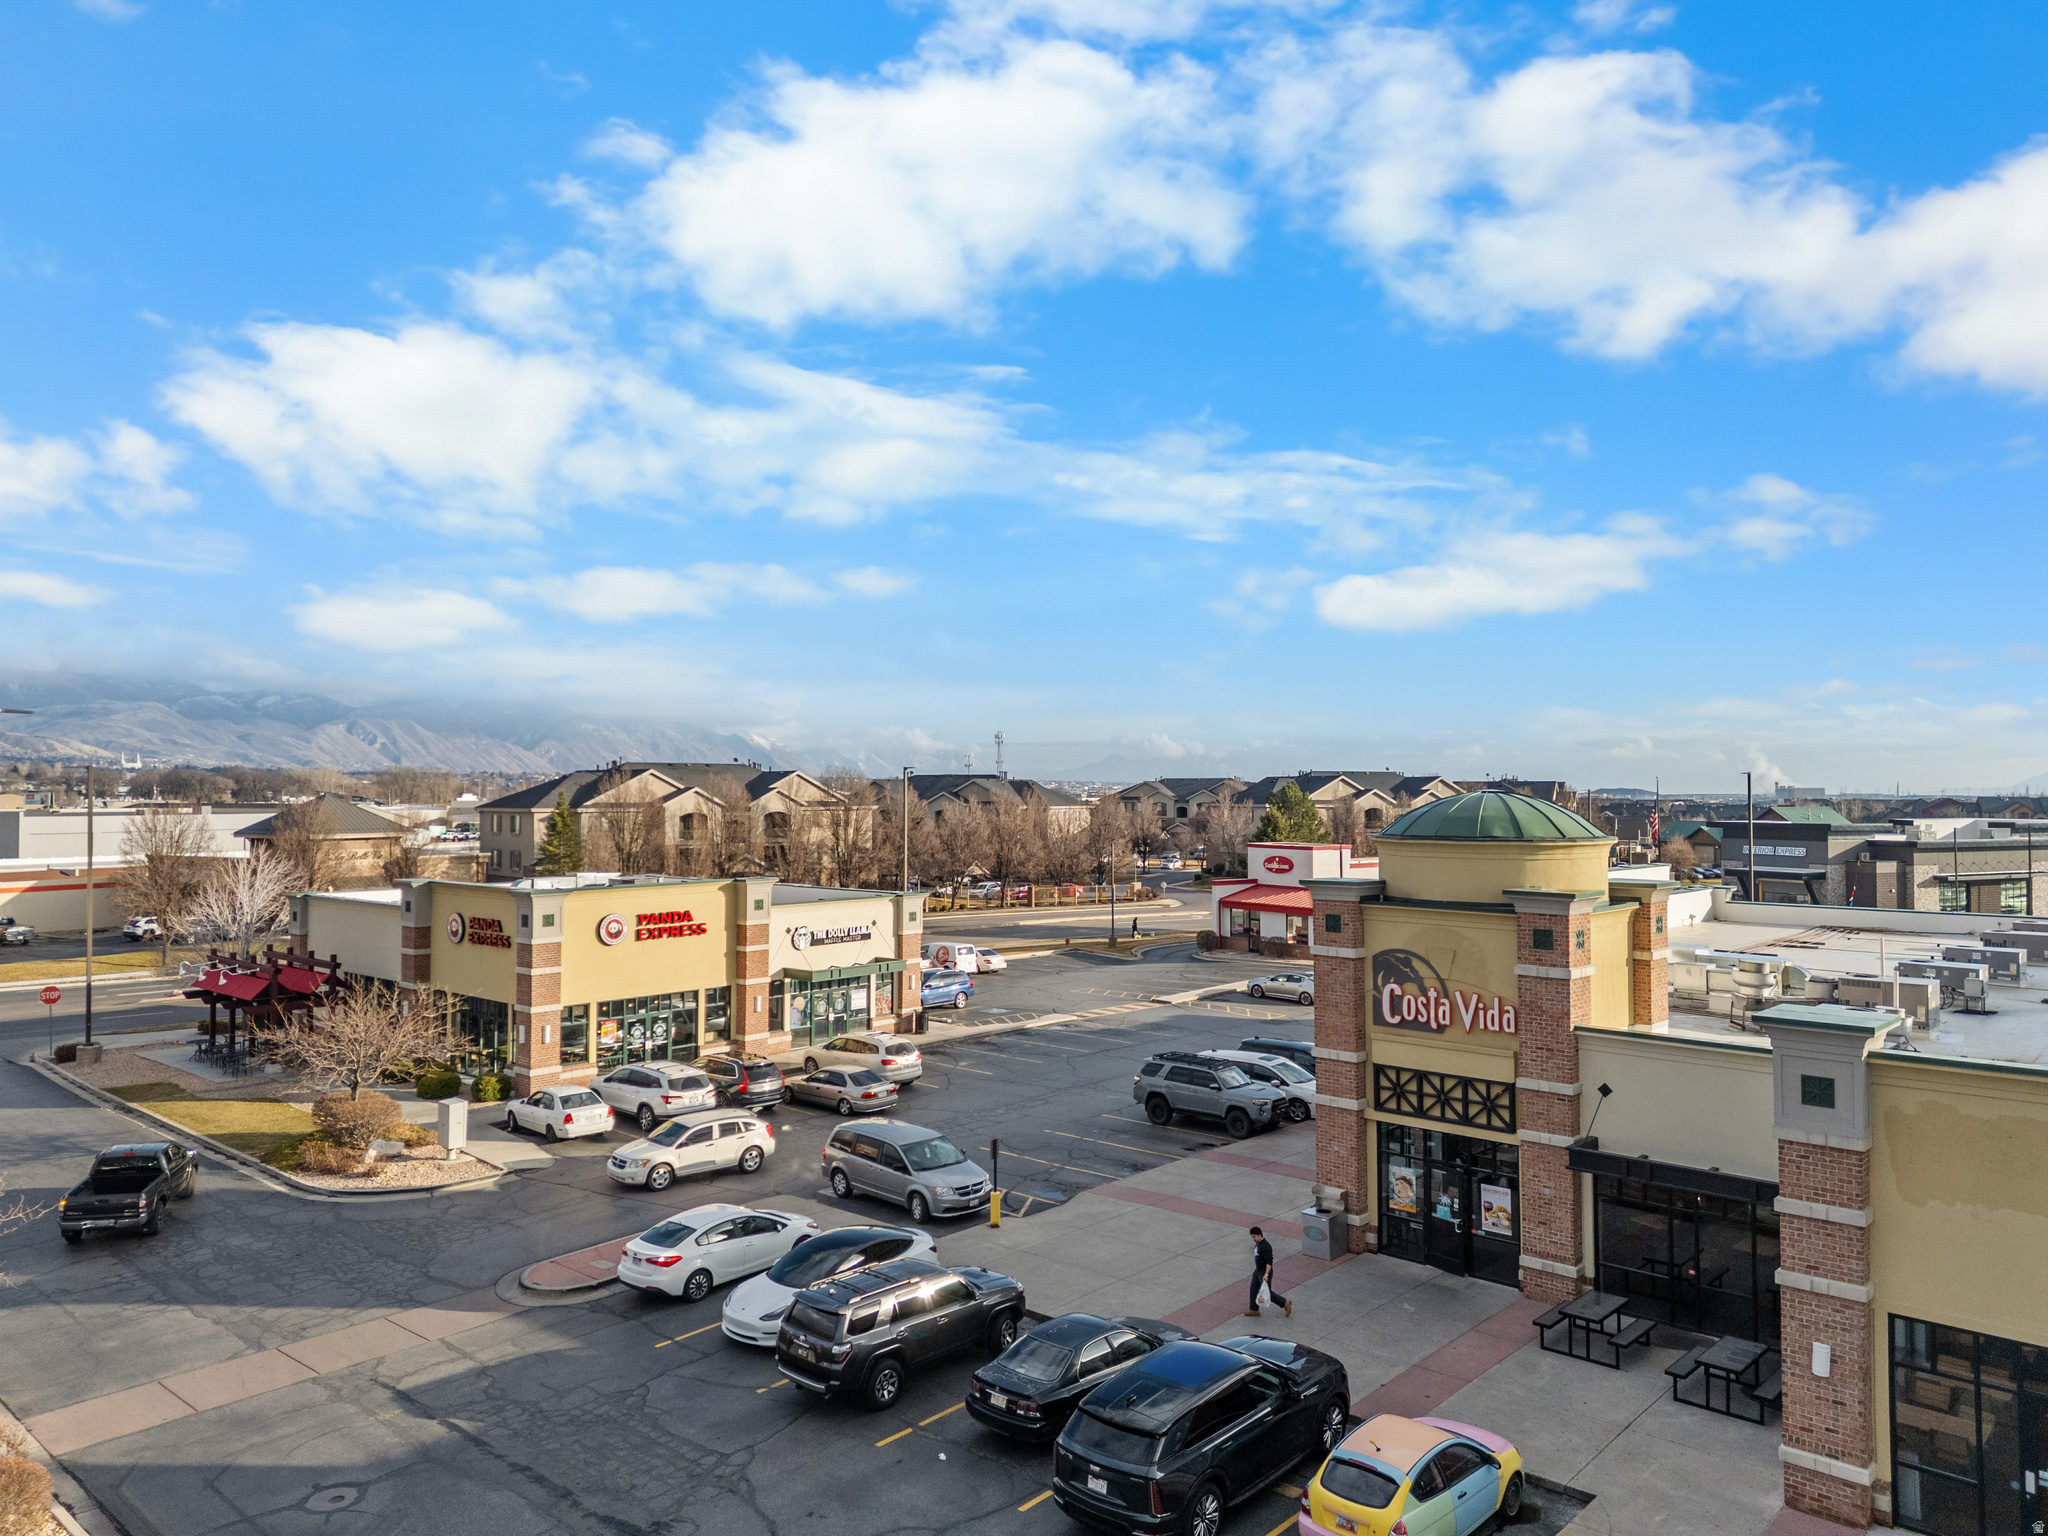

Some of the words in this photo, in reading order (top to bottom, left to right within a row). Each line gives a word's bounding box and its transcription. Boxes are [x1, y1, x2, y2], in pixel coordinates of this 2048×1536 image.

[1742, 846, 1774, 854] INERIOR
[1775, 847, 1806, 856] EXPRESS
[468, 916, 502, 932] PANDA
[636, 910, 694, 927] PANDA
[468, 931, 511, 948] EXPRESS
[636, 923, 707, 941] EXPRESS
[812, 929, 827, 939] THE
[828, 927, 849, 938] DOLLY
[849, 925, 871, 936] LLAMA
[40, 991, 60, 1000] STOP
[1382, 983, 1451, 1029] Costa
[1454, 989, 1517, 1035] Vida
